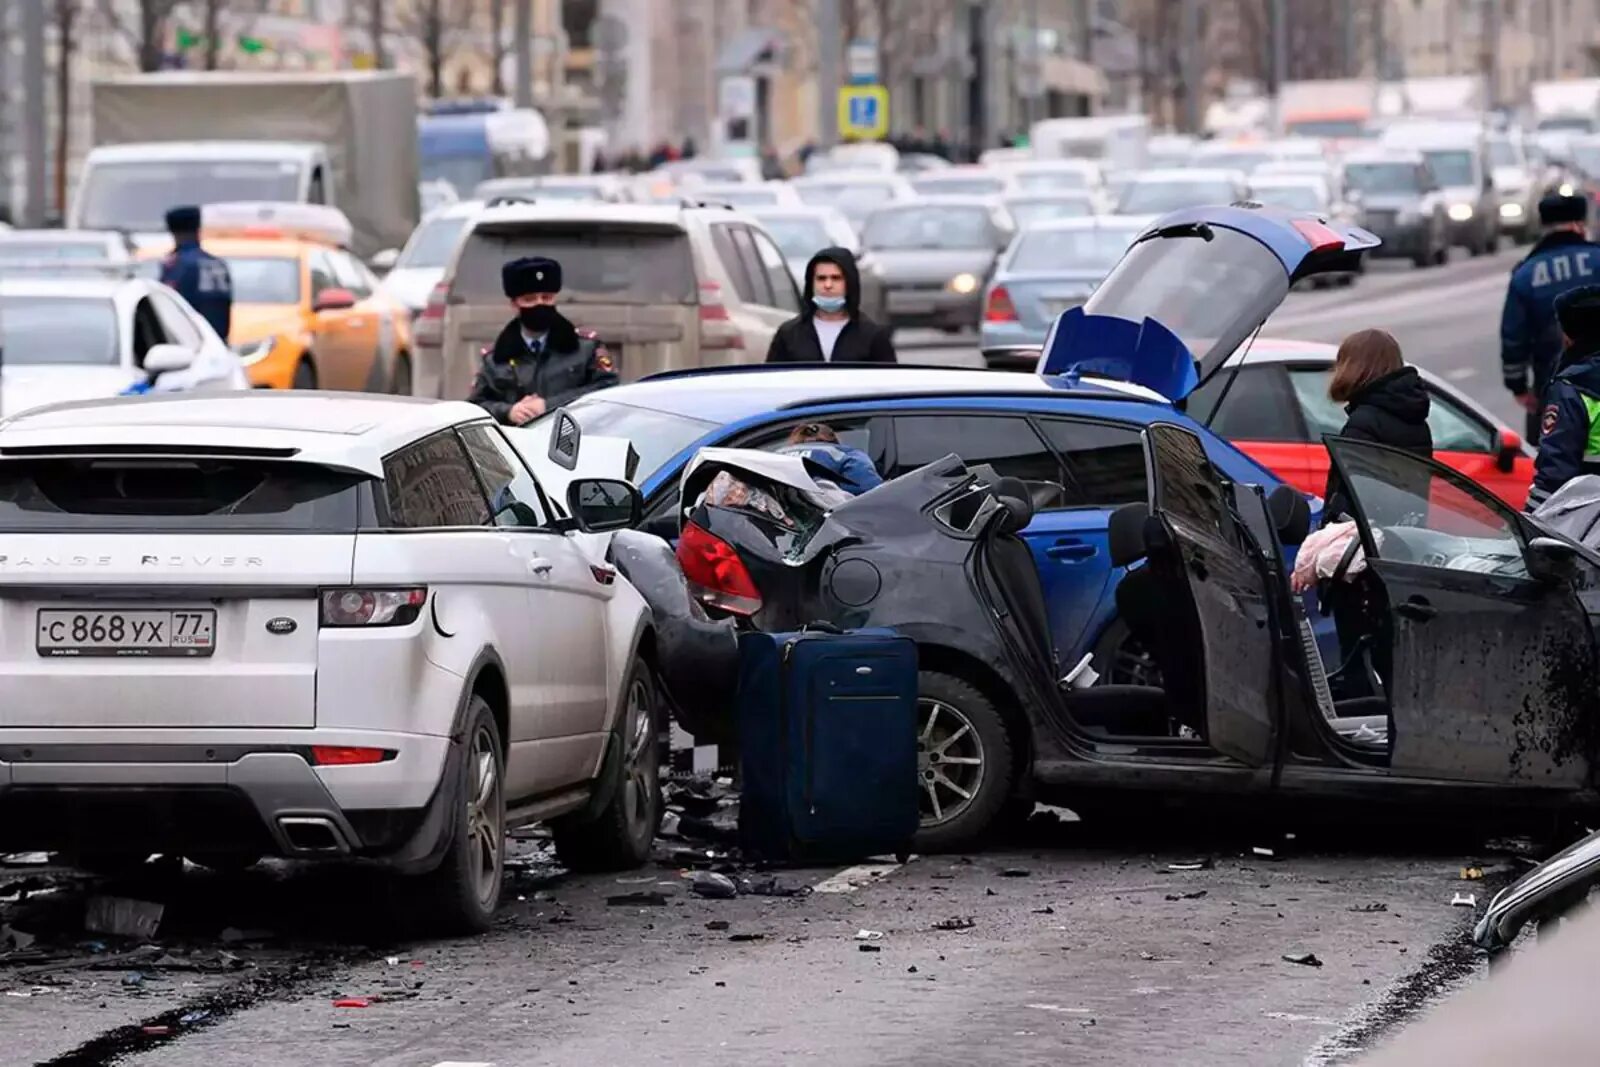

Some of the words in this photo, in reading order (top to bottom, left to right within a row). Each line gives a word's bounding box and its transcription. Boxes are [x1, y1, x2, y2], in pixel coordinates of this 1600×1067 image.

[1531, 252, 1593, 287] ДПС
[141, 555, 263, 566] ROVER
[175, 614, 203, 635] 77
[173, 635, 194, 643] RUS
